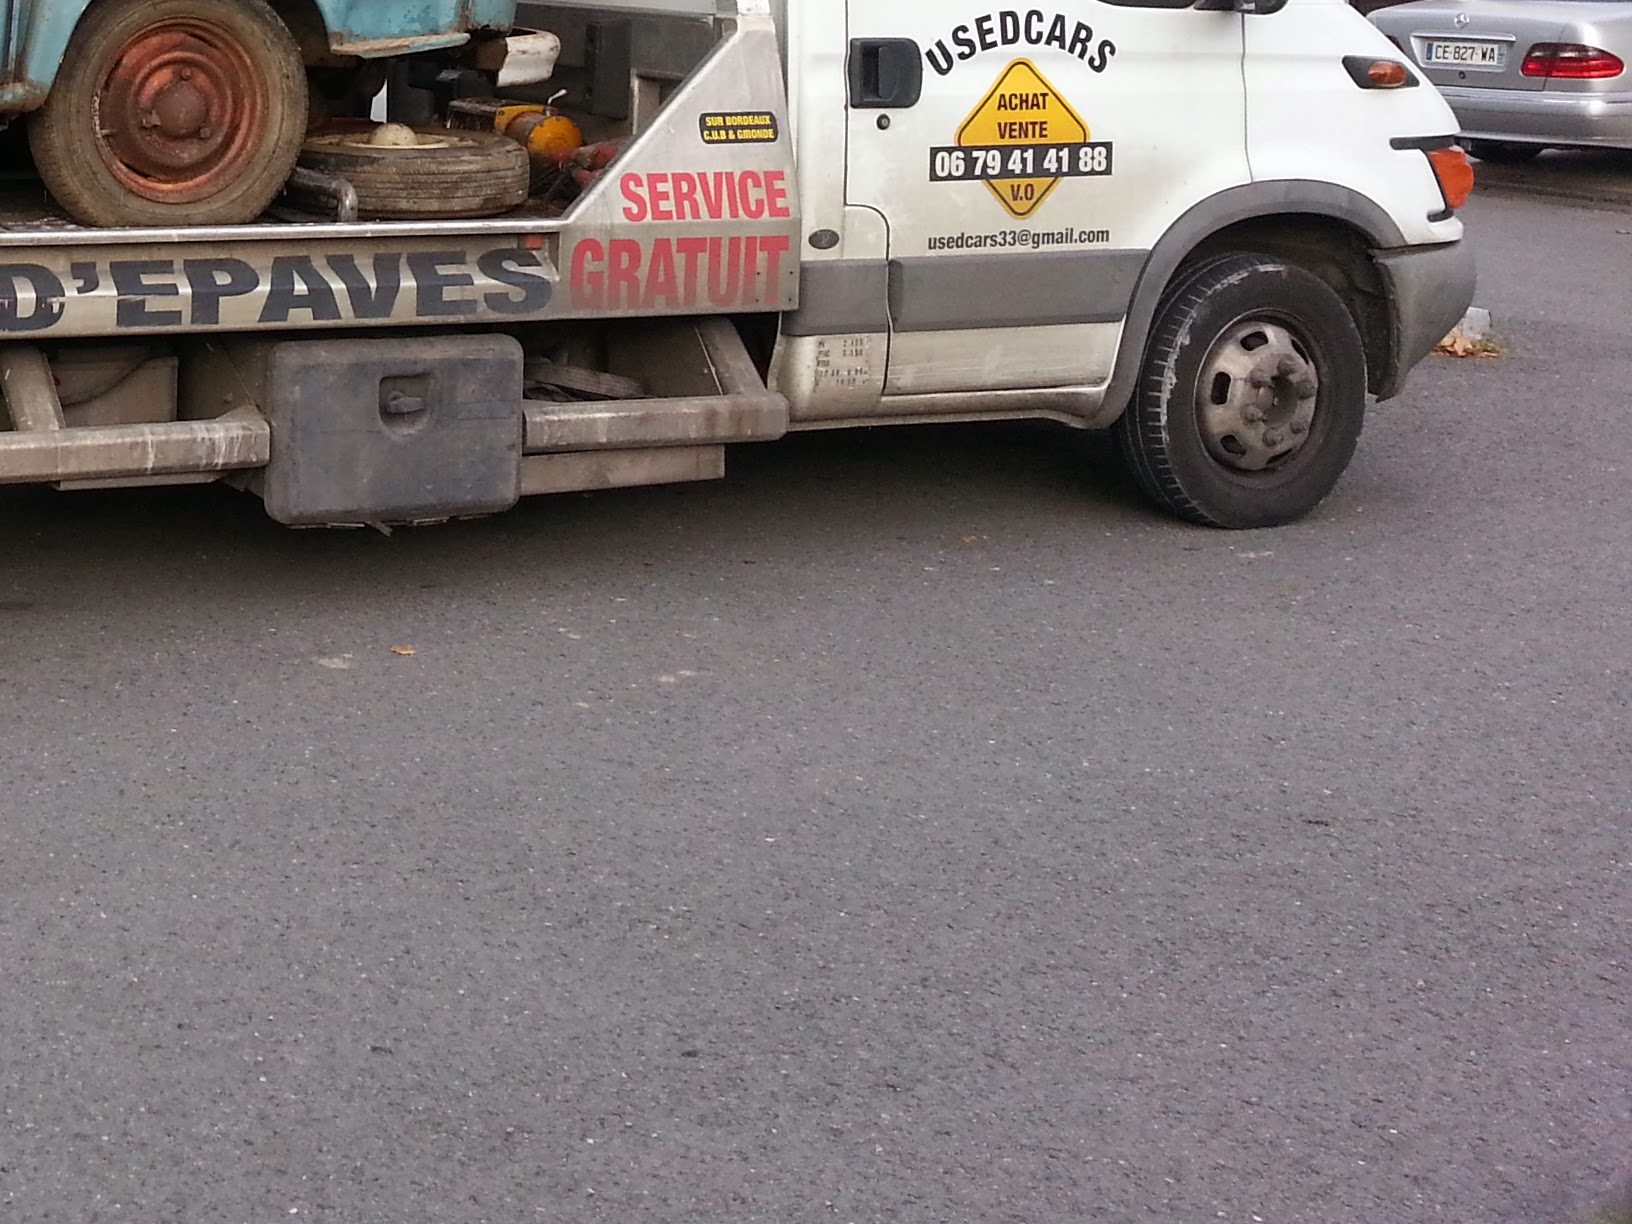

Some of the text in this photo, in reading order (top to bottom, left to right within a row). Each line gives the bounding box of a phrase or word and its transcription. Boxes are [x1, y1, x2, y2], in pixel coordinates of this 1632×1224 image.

[925, 9, 1116, 76] USEDCARS
[997, 93, 1049, 111] ACHAT
[705, 115, 771, 126] SUR BORDEAUX
[997, 121, 1048, 139] VENTE
[728, 129, 736, 139] &
[737, 129, 775, 139] GIRONDE
[935, 146, 1107, 176] 06 79 41 41 88
[620, 170, 790, 222] SERVICE
[1010, 184, 1035, 201] V.O
[928, 227, 1110, 250] usedcars33@gmail.com
[570, 235, 790, 309] GRATUIT
